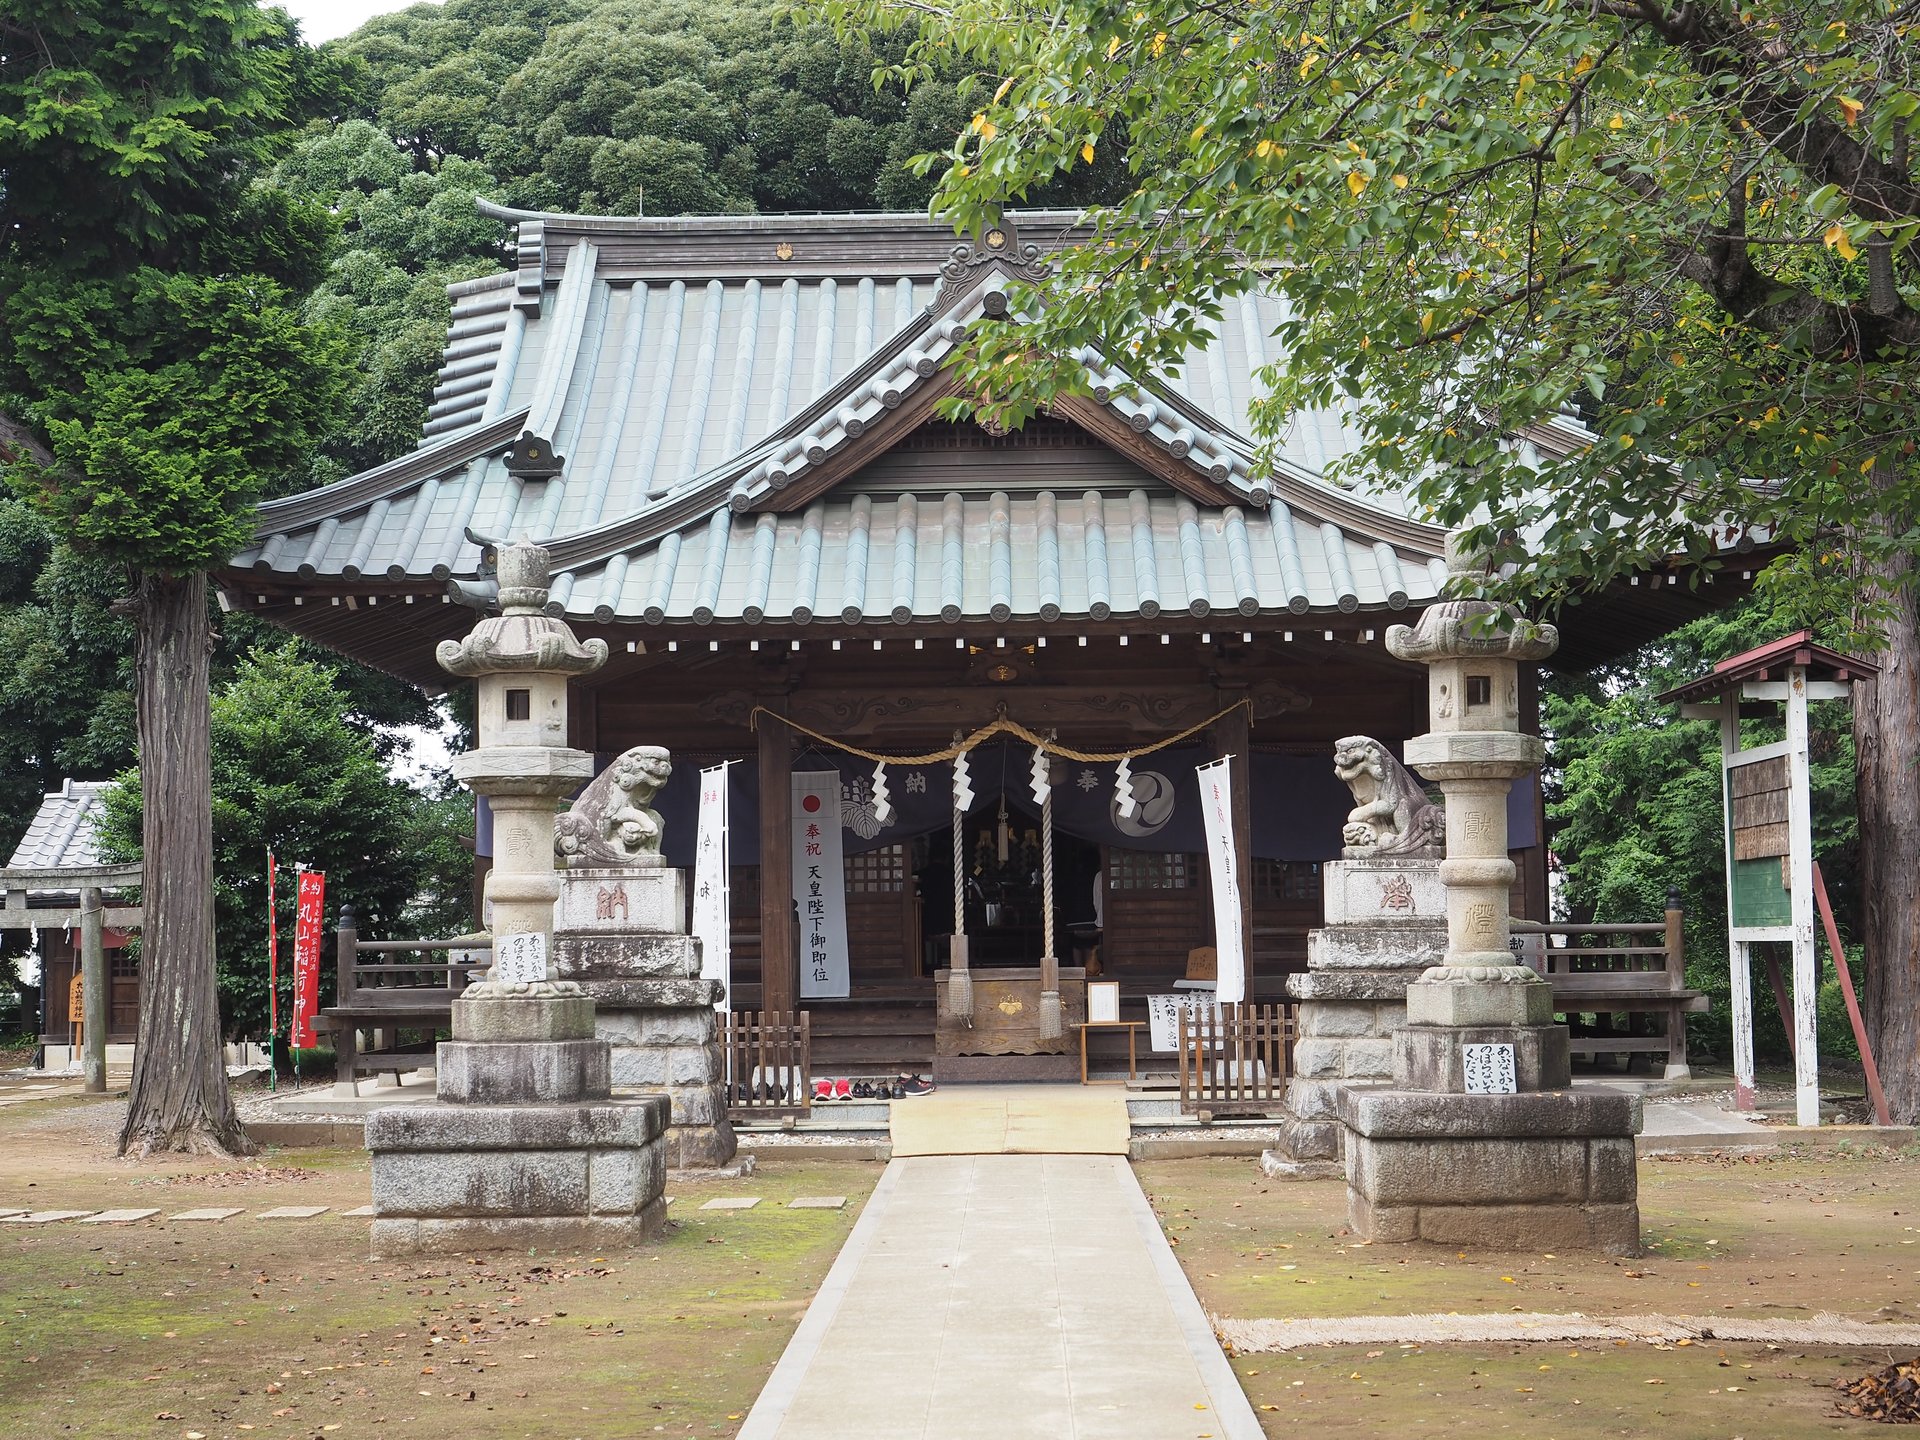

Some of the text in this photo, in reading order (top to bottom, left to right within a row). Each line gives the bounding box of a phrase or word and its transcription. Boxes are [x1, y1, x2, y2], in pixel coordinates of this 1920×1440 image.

[906, 769, 1099, 794] 奉 納
[805, 823, 829, 982] 奉祝 天皇陛下御即位
[1465, 1047, 1479, 1090] ください
[1480, 1045, 1496, 1093] のぼらないで
[1497, 1045, 1514, 1093] あぶないから
